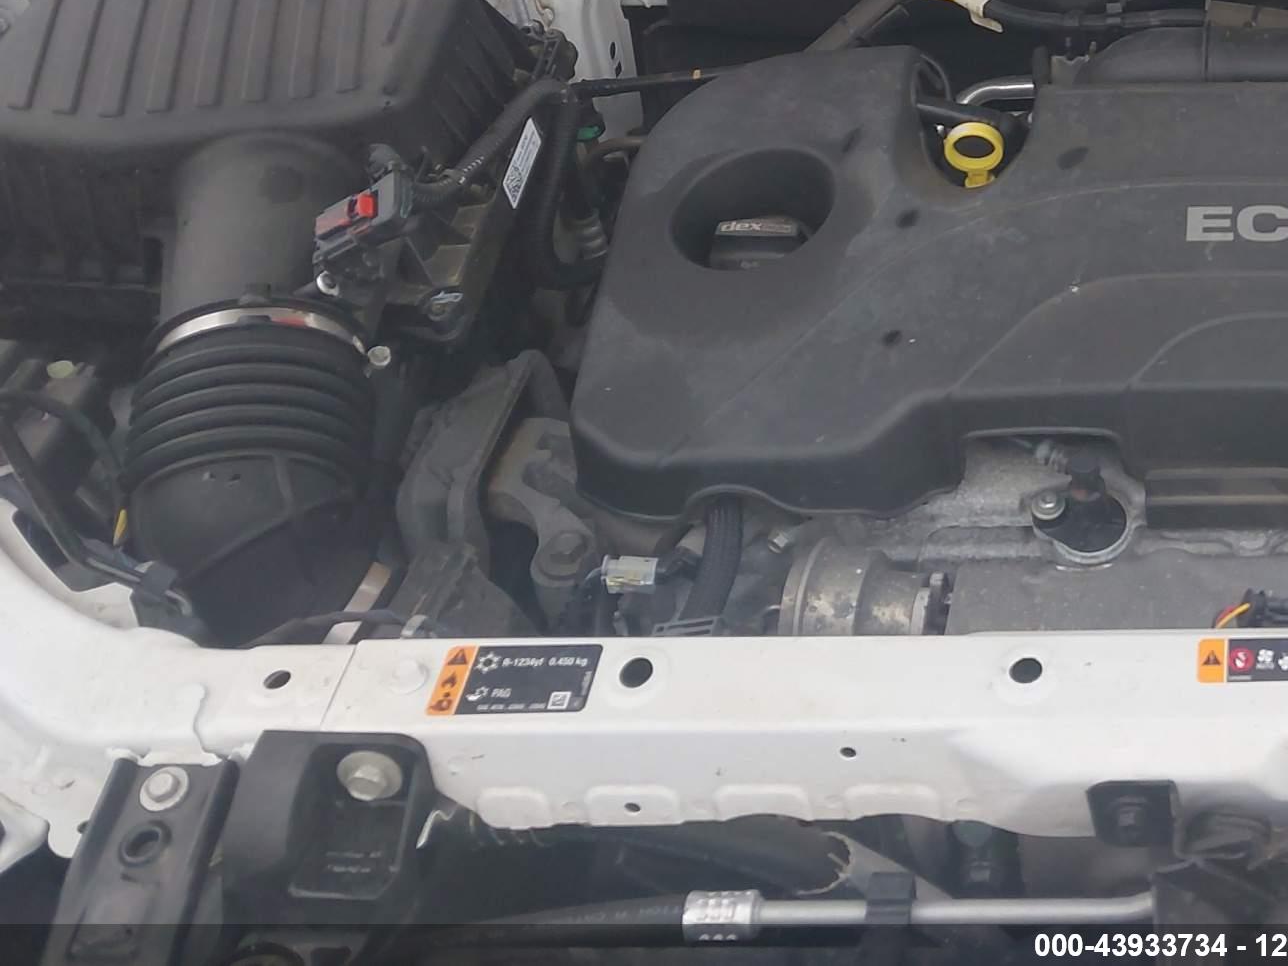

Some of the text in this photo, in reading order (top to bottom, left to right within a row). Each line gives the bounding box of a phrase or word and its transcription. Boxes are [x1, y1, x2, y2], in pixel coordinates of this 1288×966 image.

[502, 657, 588, 668] R-1234yf 0.450 kg
[491, 687, 512, 698] PAG
